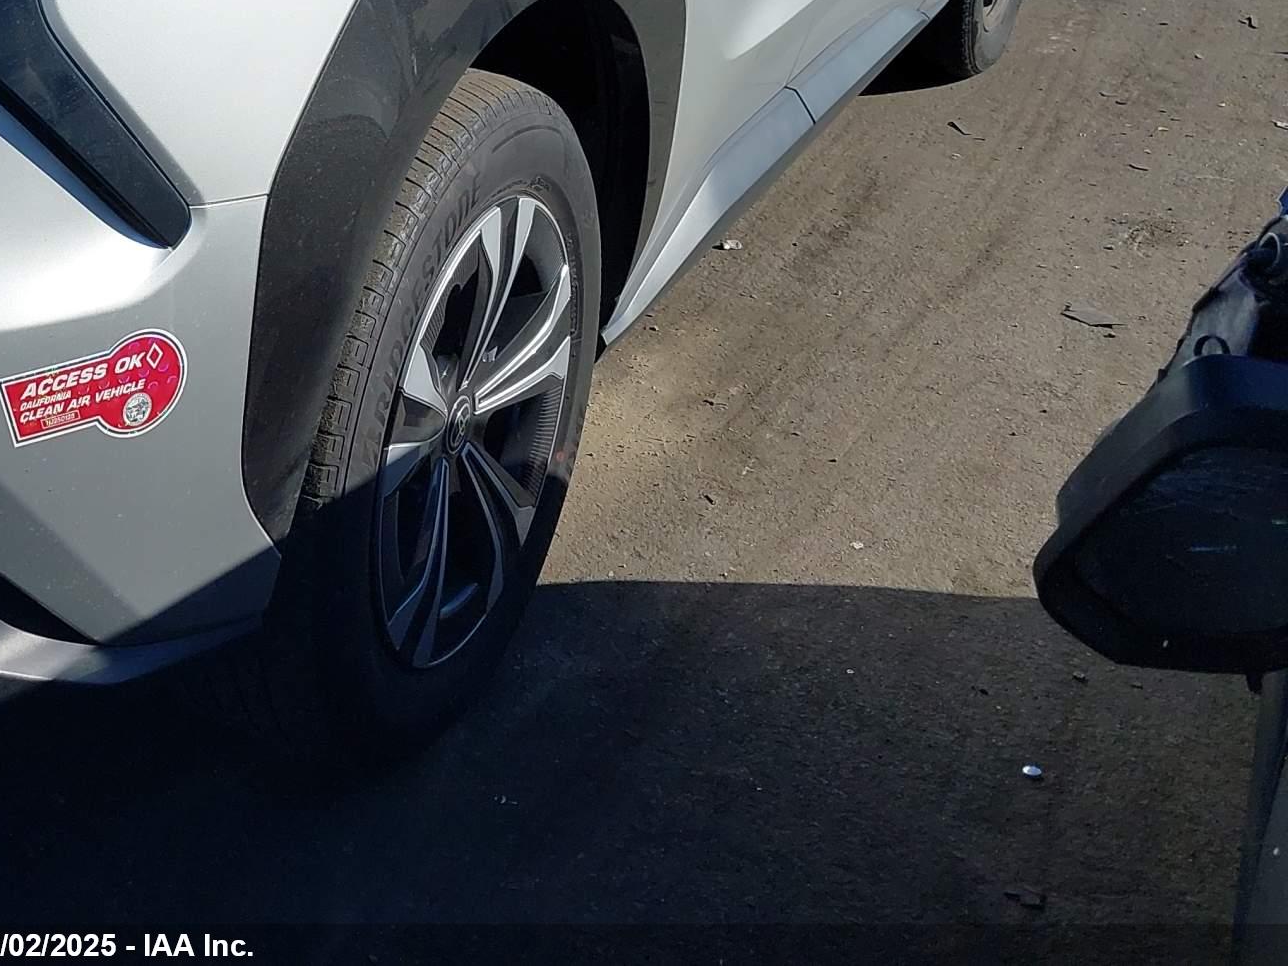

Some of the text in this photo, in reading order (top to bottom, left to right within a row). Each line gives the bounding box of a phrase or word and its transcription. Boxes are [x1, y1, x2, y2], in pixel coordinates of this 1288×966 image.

[19, 351, 146, 401] ACCESS OK
[19, 390, 72, 412] CALIFORNIA
[19, 404, 64, 425] CLEAN
[66, 395, 92, 412] AIR
[94, 379, 146, 404] VEHICLE
